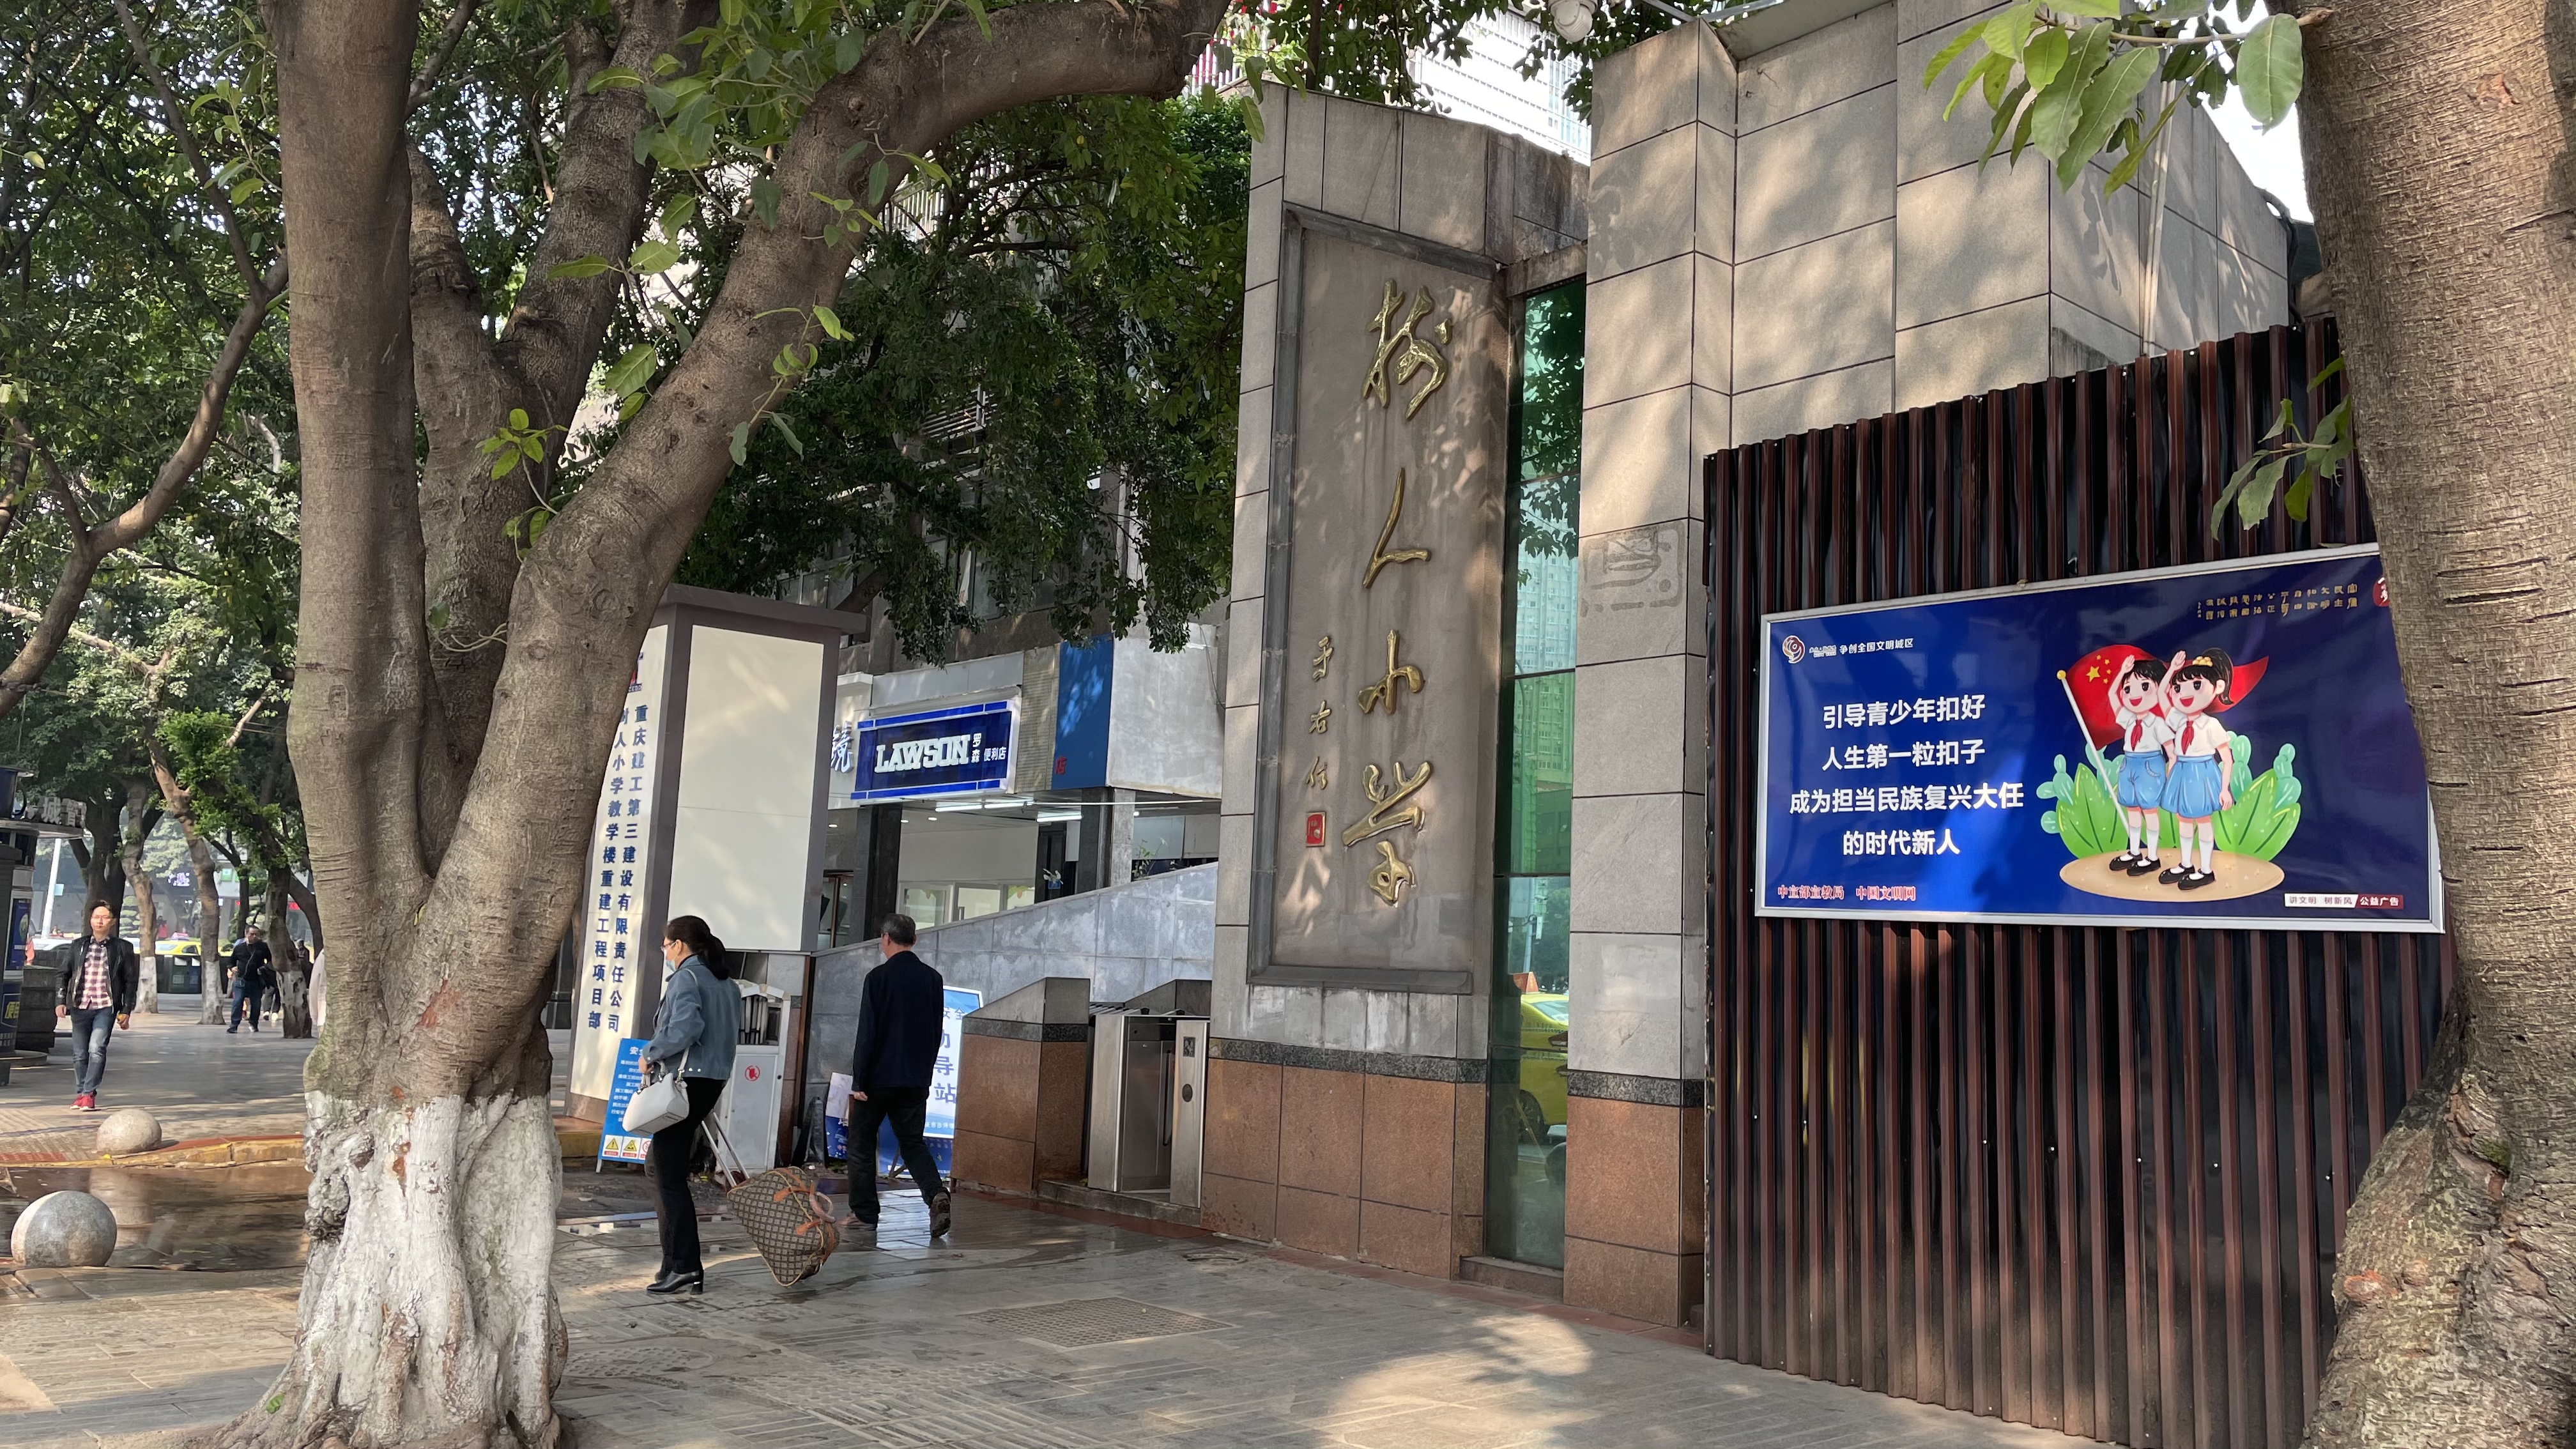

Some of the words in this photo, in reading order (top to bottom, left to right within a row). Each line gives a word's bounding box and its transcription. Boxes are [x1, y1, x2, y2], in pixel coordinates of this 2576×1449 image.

[1839, 638, 1914, 655] 争创全国文明城区
[1822, 694, 1986, 730] 引导青少年扣好
[874, 733, 970, 774] LAWSON
[971, 732, 982, 763] 罗森
[983, 746, 1007, 762] 便利店
[1821, 738, 1986, 771] 人生第一粒扣子
[1789, 781, 2025, 815] 成为担当民族复兴大任
[1843, 828, 1961, 856] 的时代新人
[608, 698, 648, 1033] 重庆建工第三建设有限责任公司
[1777, 884, 1844, 900] 中宣部宣教局
[1855, 885, 1916, 901] 中国文明网
[2289, 896, 2317, 905] 讲文明
[2324, 896, 2352, 905] 树新风
[2359, 896, 2399, 907] 公益广告
